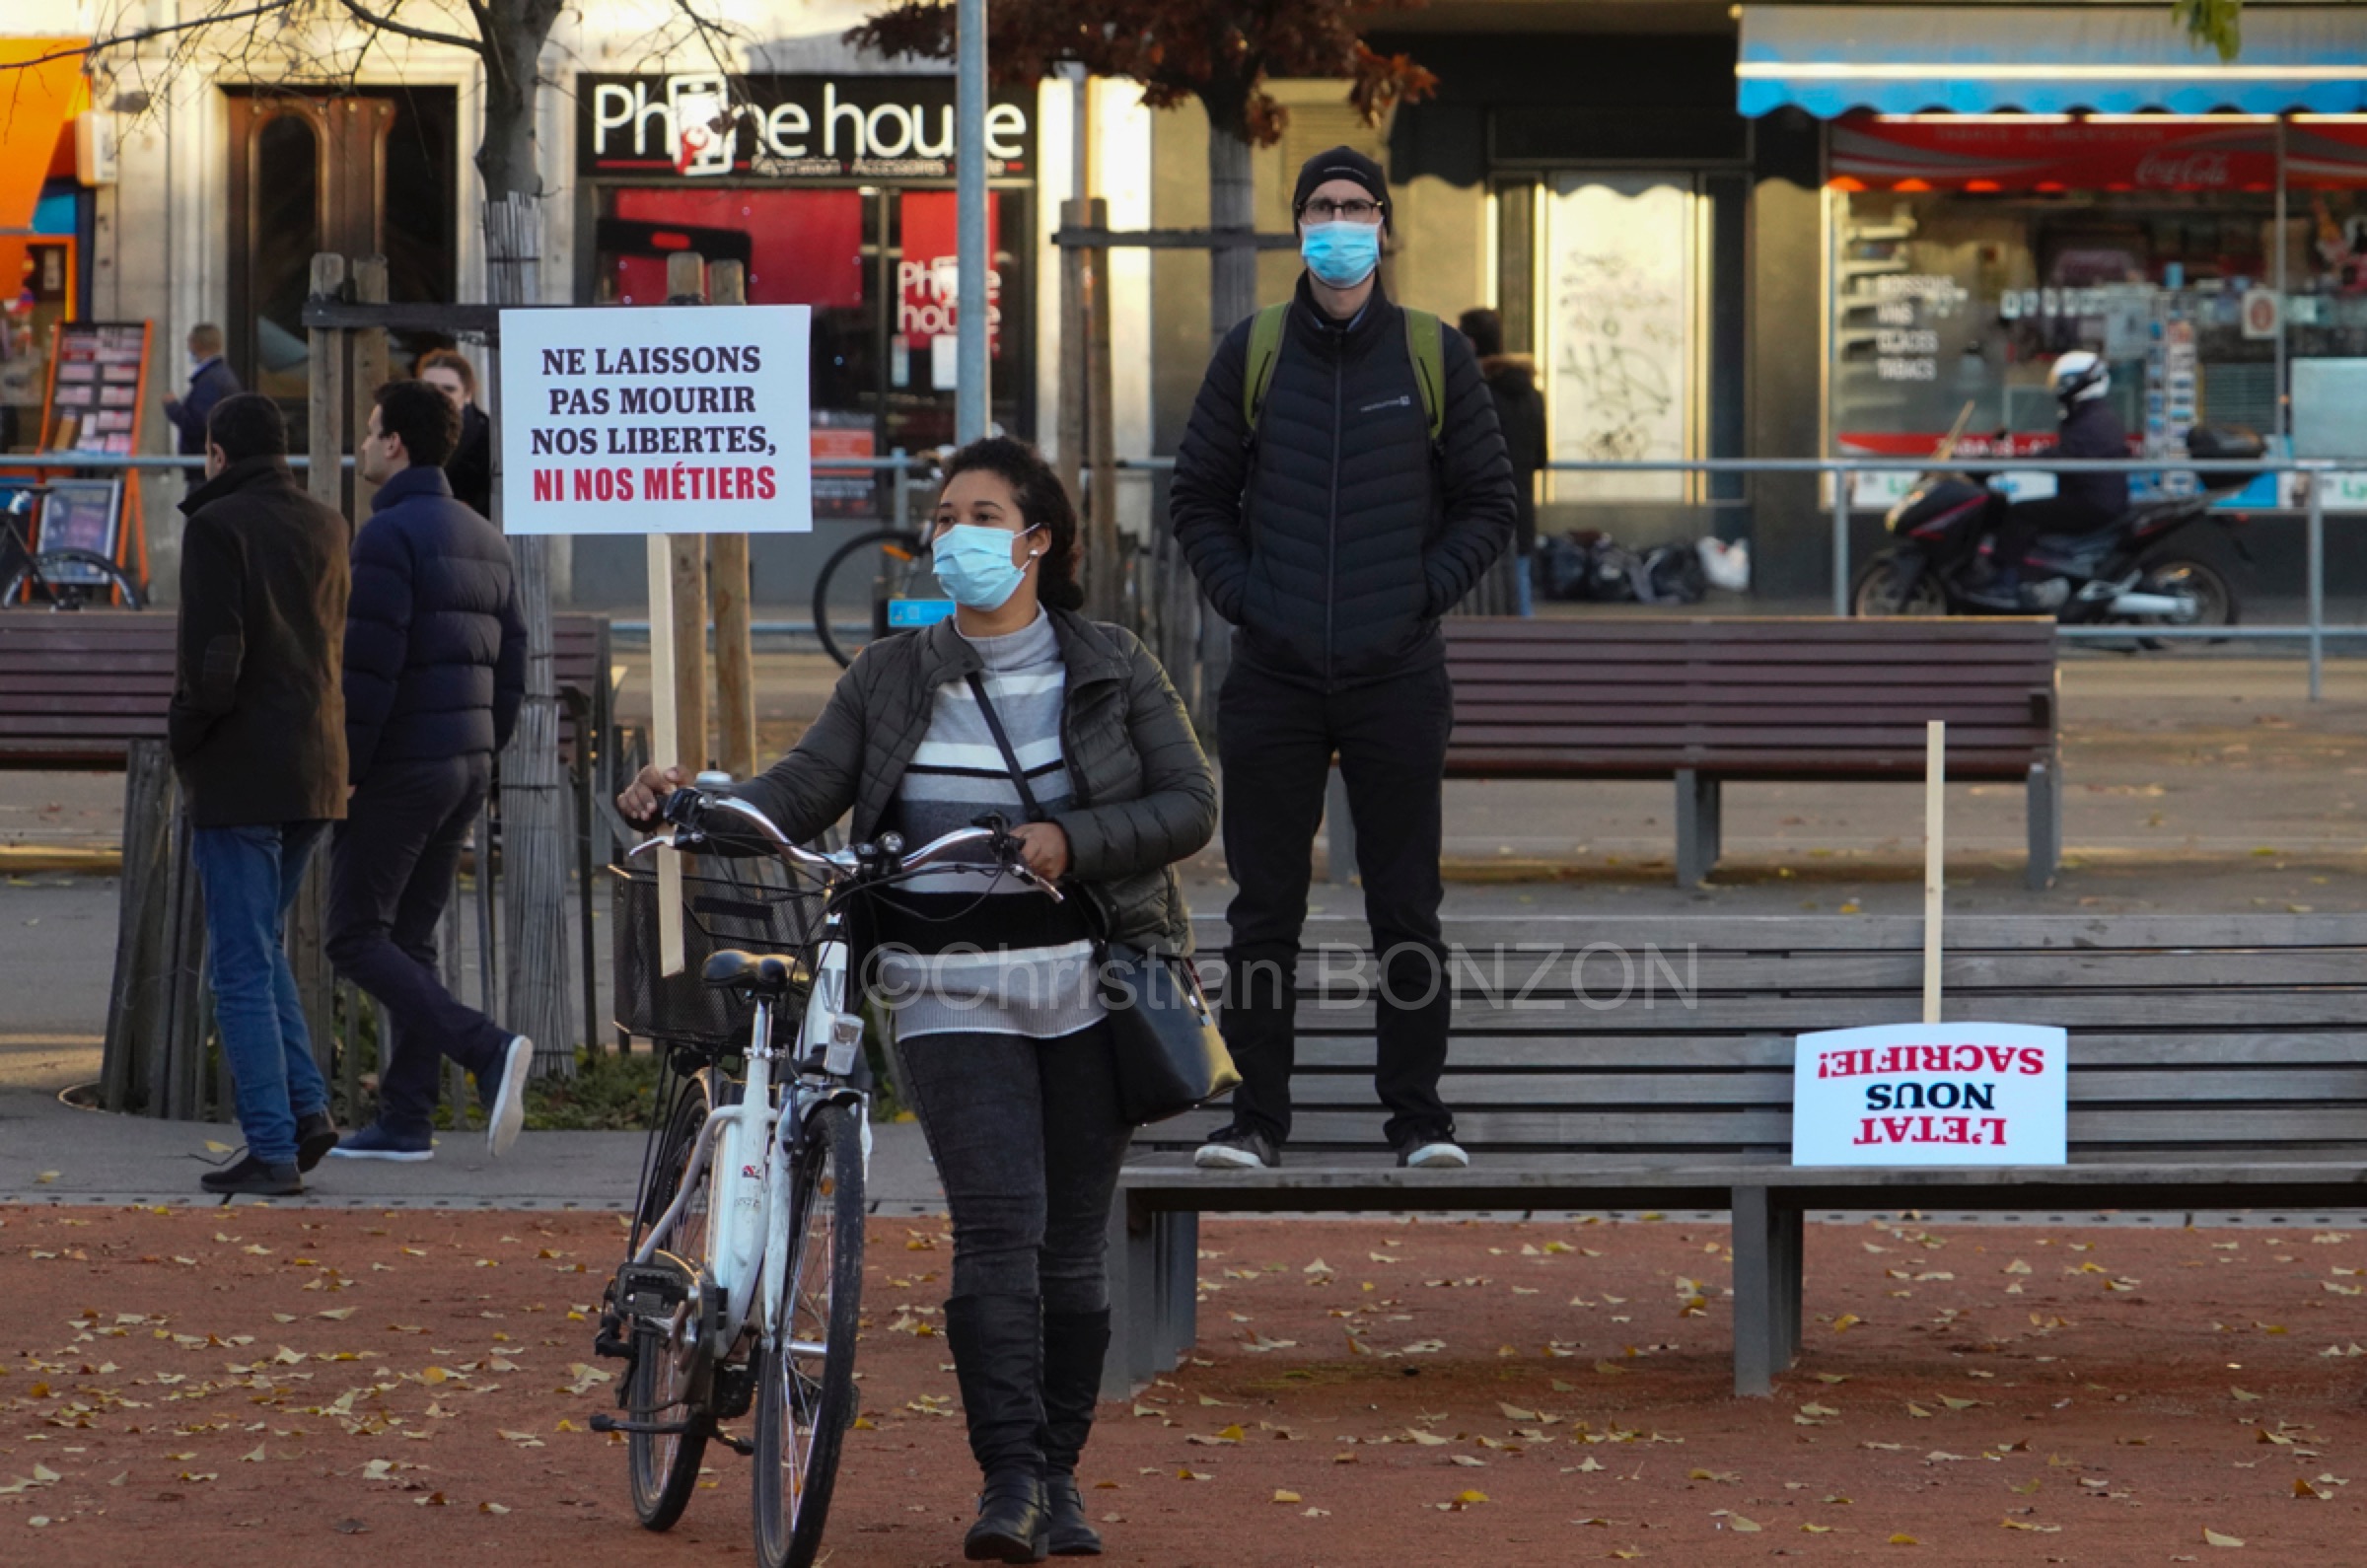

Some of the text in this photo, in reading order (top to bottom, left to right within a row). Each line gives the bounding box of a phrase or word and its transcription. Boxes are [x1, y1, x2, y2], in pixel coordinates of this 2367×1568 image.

[824, 82, 1027, 158] houe
[897, 257, 1001, 299] Phe
[897, 296, 1001, 334] houe
[541, 345, 761, 375] NE LAISSONS
[549, 386, 756, 415] PAS MOURIR
[531, 425, 777, 457] NOS LIBERTES,
[534, 467, 564, 502] NI
[573, 467, 634, 502] NOS
[643, 461, 776, 500] MÉTIERS
[1818, 1044, 2044, 1079] SACRIFIE!
[1865, 1082, 1995, 1110] NOUS
[1853, 1115, 2007, 1145] L'ETAT
